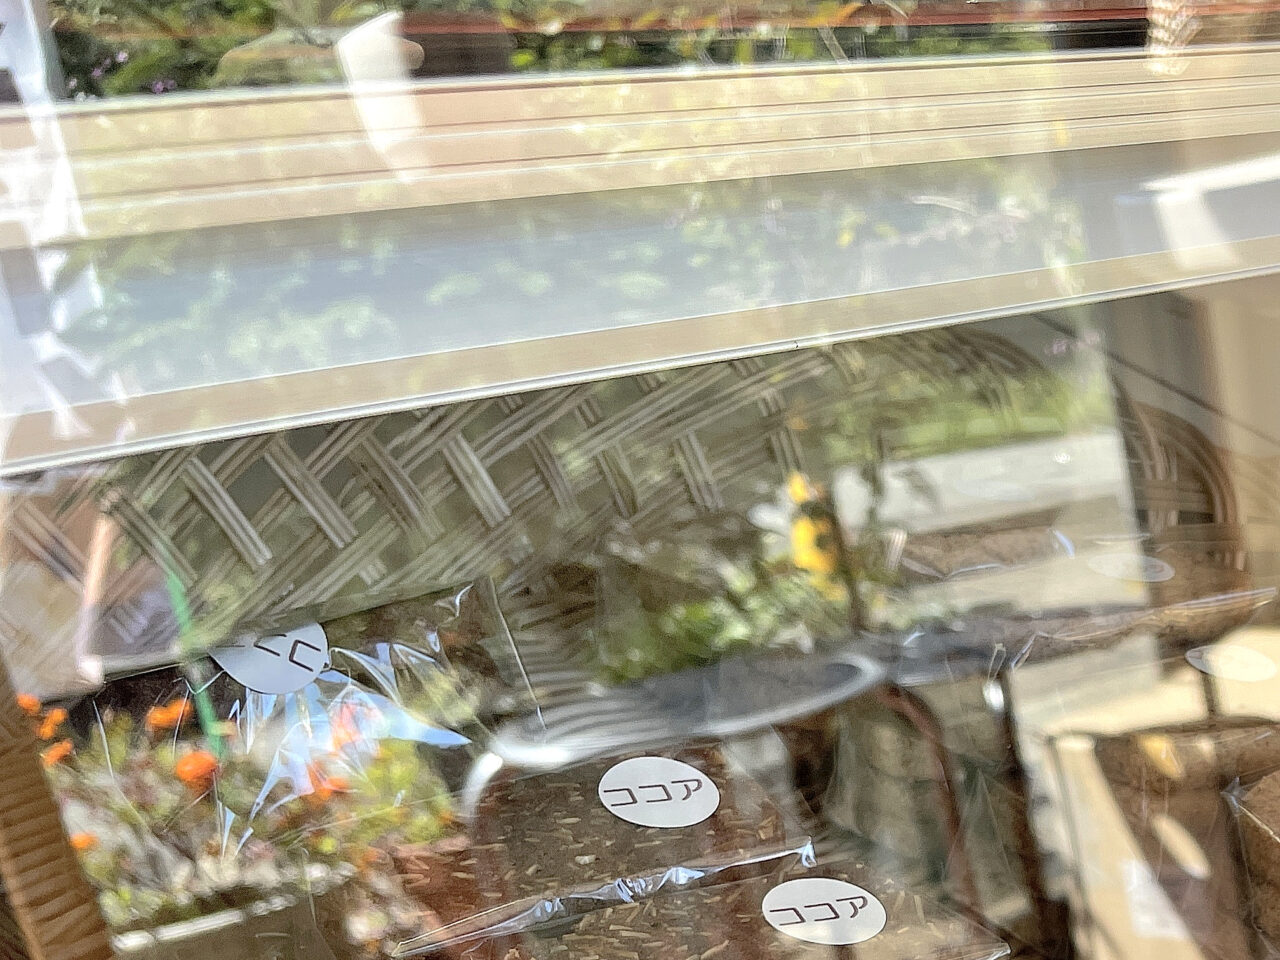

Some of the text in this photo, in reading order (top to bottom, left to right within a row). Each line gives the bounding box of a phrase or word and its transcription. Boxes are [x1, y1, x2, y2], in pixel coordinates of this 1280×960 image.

[603, 777, 704, 808] ココア
[769, 896, 869, 924] ココア
